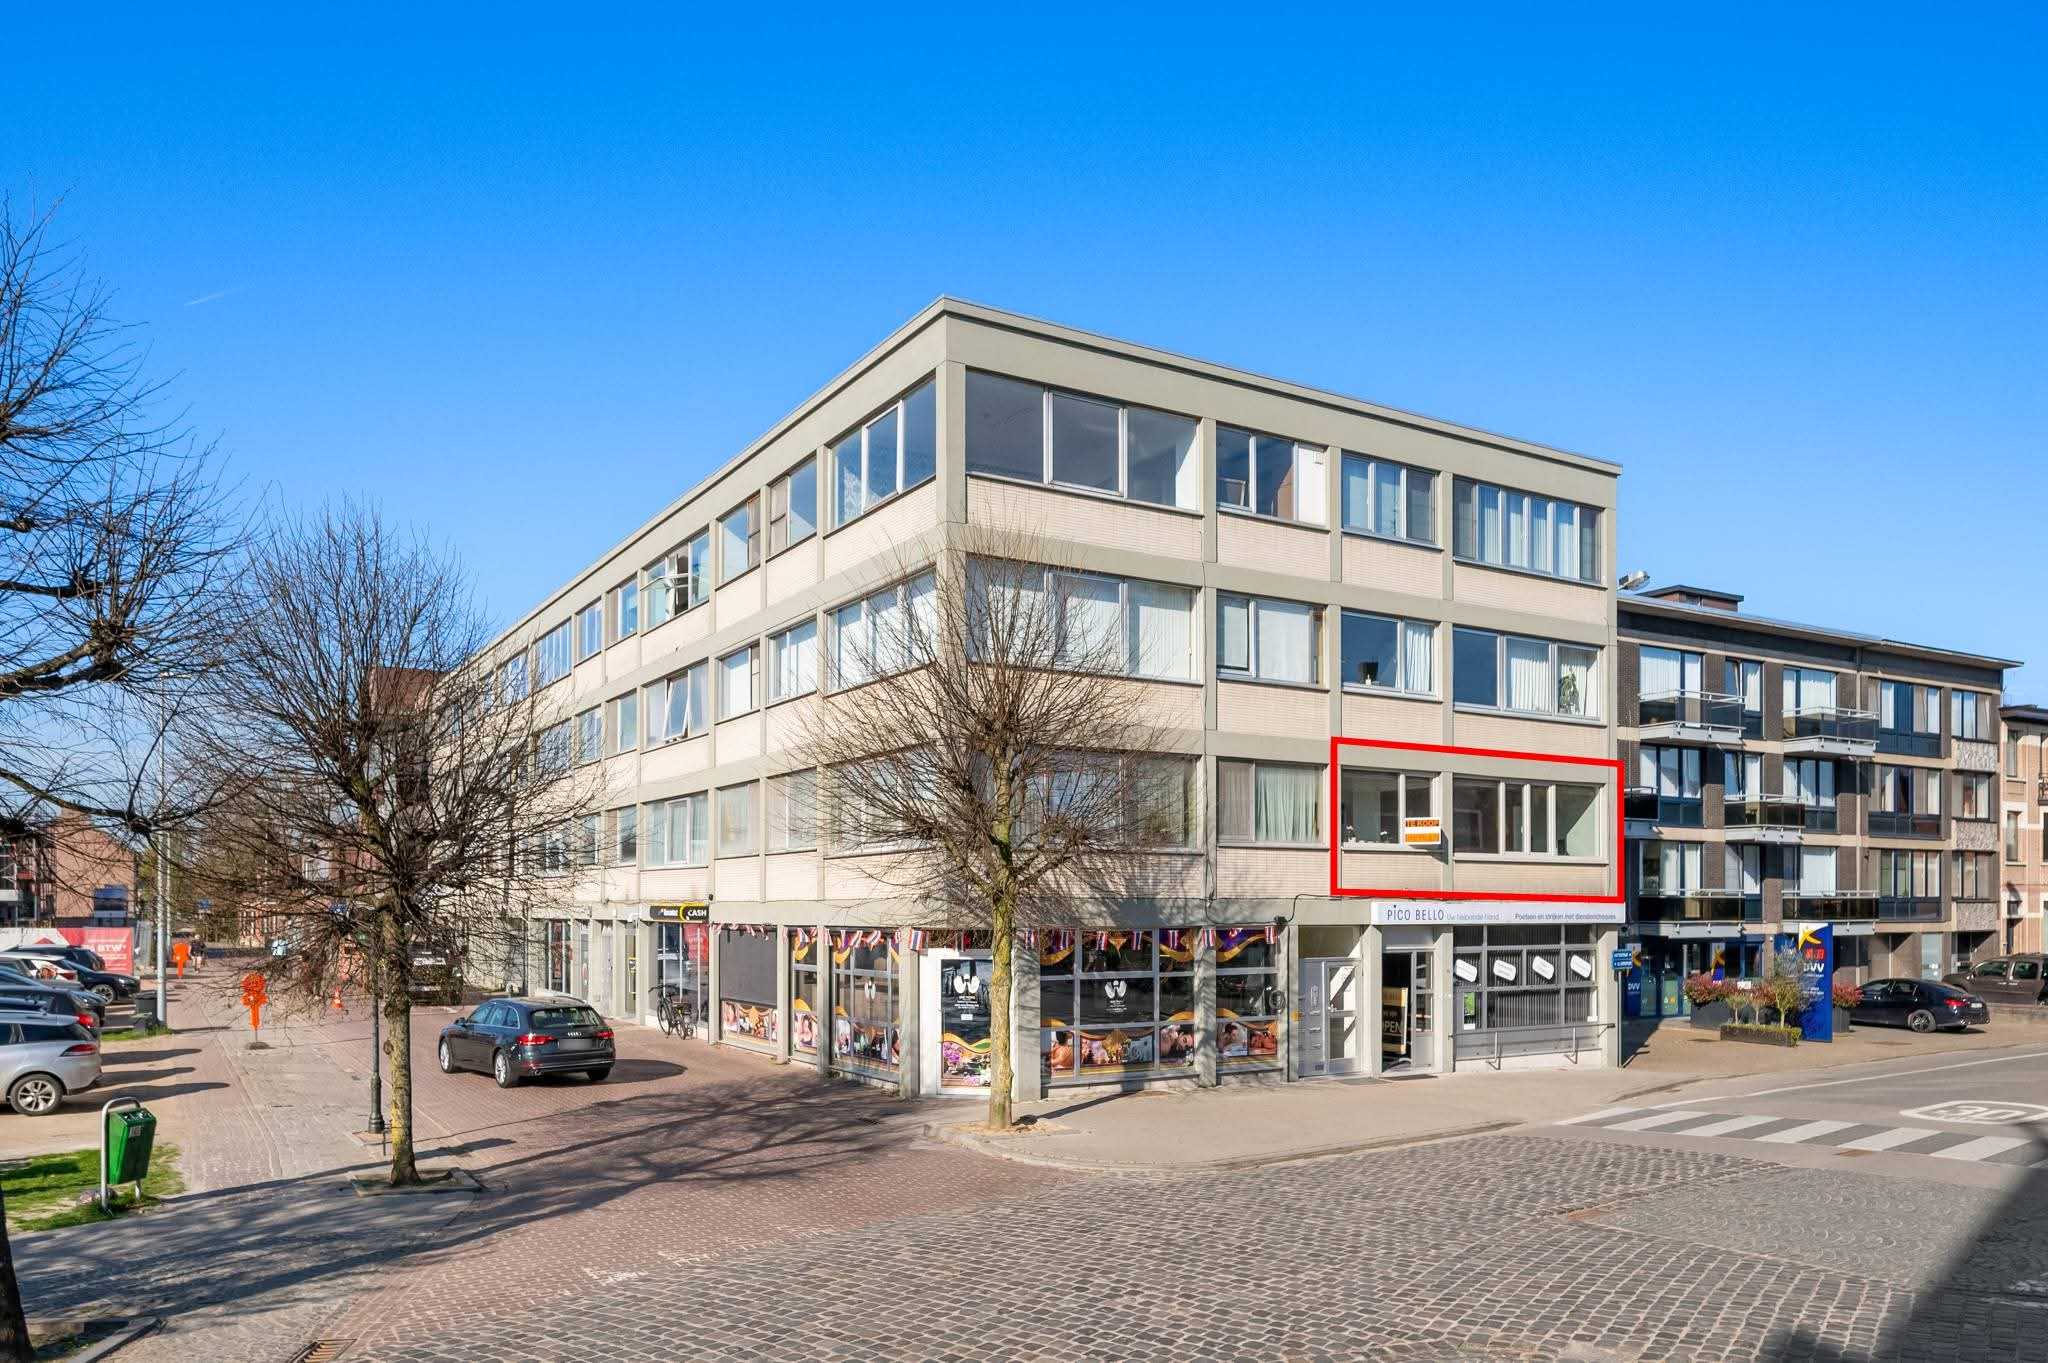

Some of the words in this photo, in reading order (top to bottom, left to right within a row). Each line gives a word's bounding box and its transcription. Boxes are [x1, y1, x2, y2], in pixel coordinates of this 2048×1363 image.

[687, 909, 707, 917] CASH
[1415, 909, 1444, 920] BELLO
[1803, 962, 1825, 973] DVV
[1383, 1020, 1402, 1033] PEN
